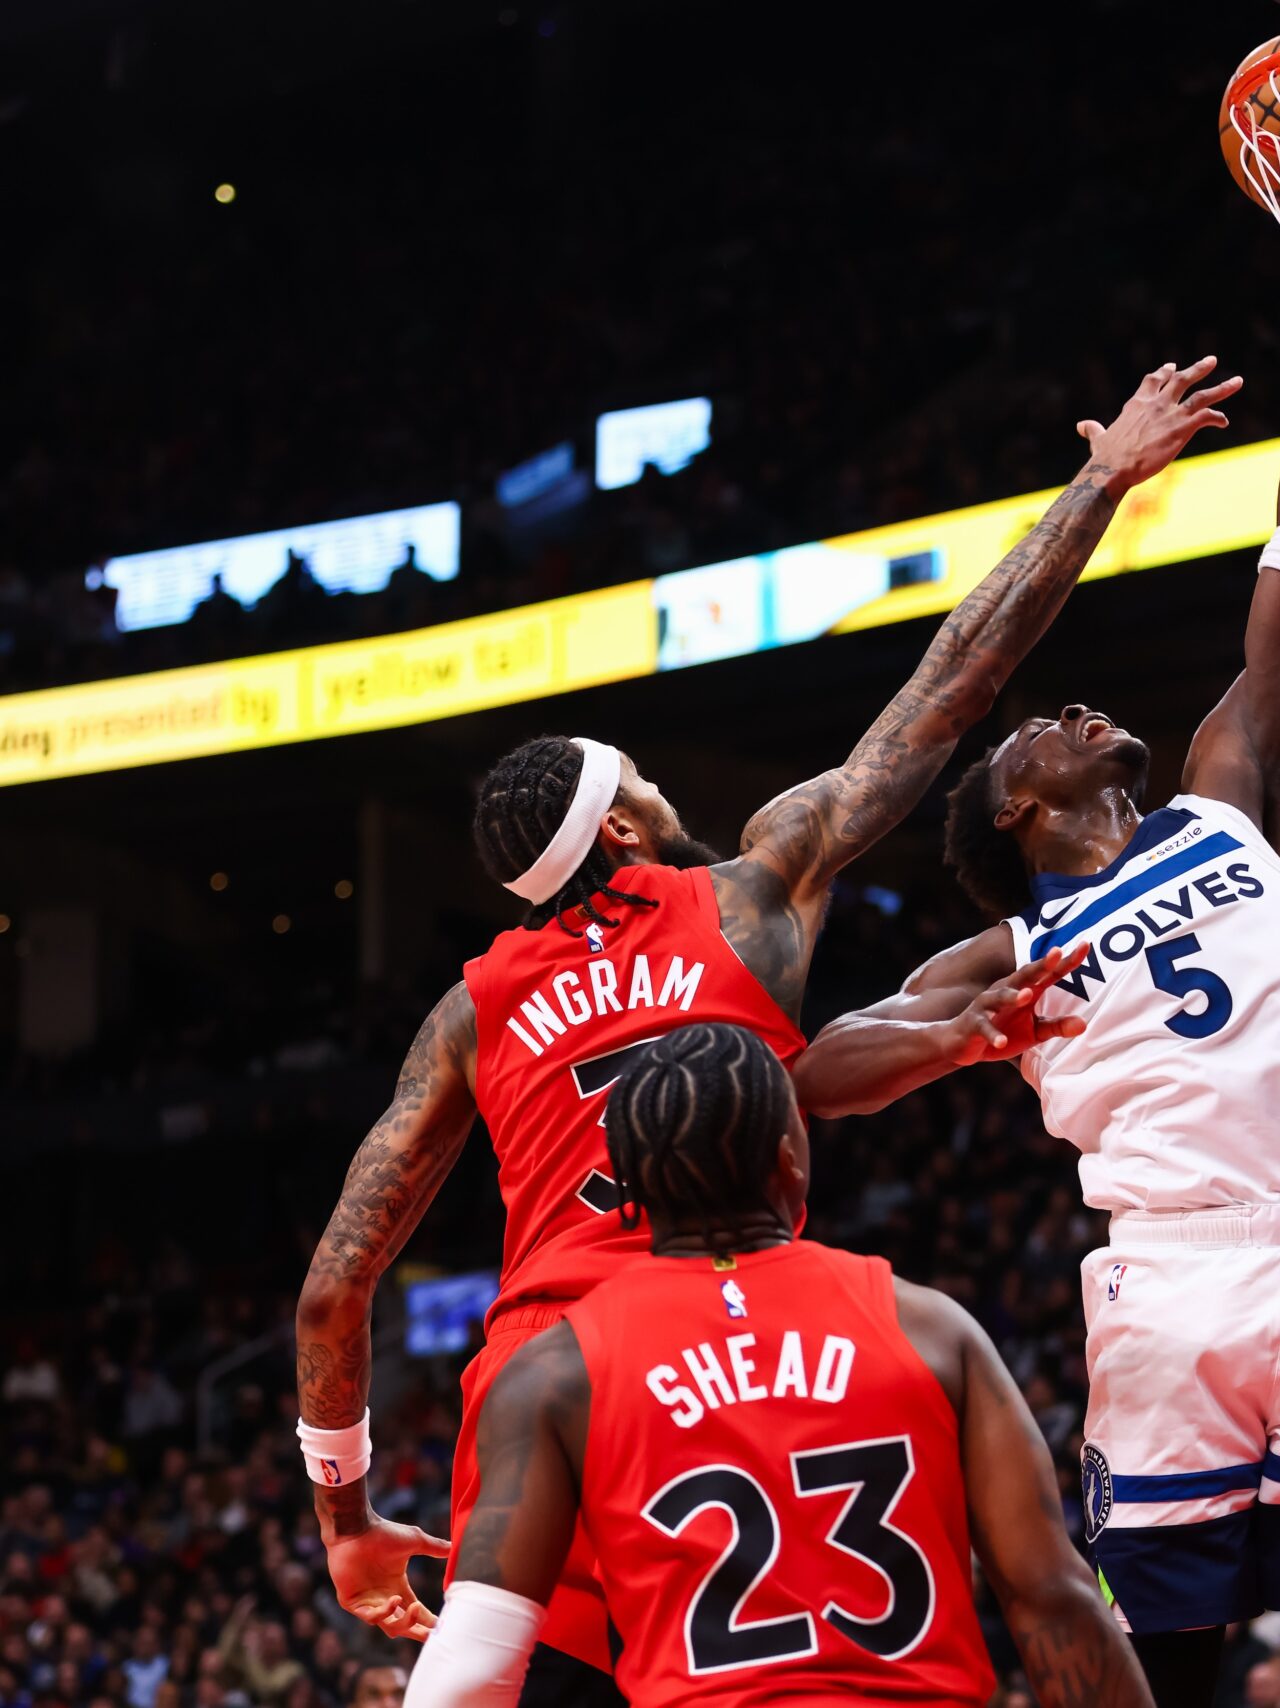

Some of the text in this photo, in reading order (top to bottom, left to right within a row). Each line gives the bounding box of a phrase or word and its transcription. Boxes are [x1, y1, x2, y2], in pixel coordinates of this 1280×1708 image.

[1156, 826, 1203, 857] sezzle
[1054, 863, 1265, 1002] WOLVES
[506, 954, 705, 1057] INGRAM
[1144, 932, 1233, 1039] 5
[646, 1331, 856, 1428] SHEAD
[1087, 1448, 1111, 1526] TIMBERWOLVES
[641, 1434, 936, 1676] 23
